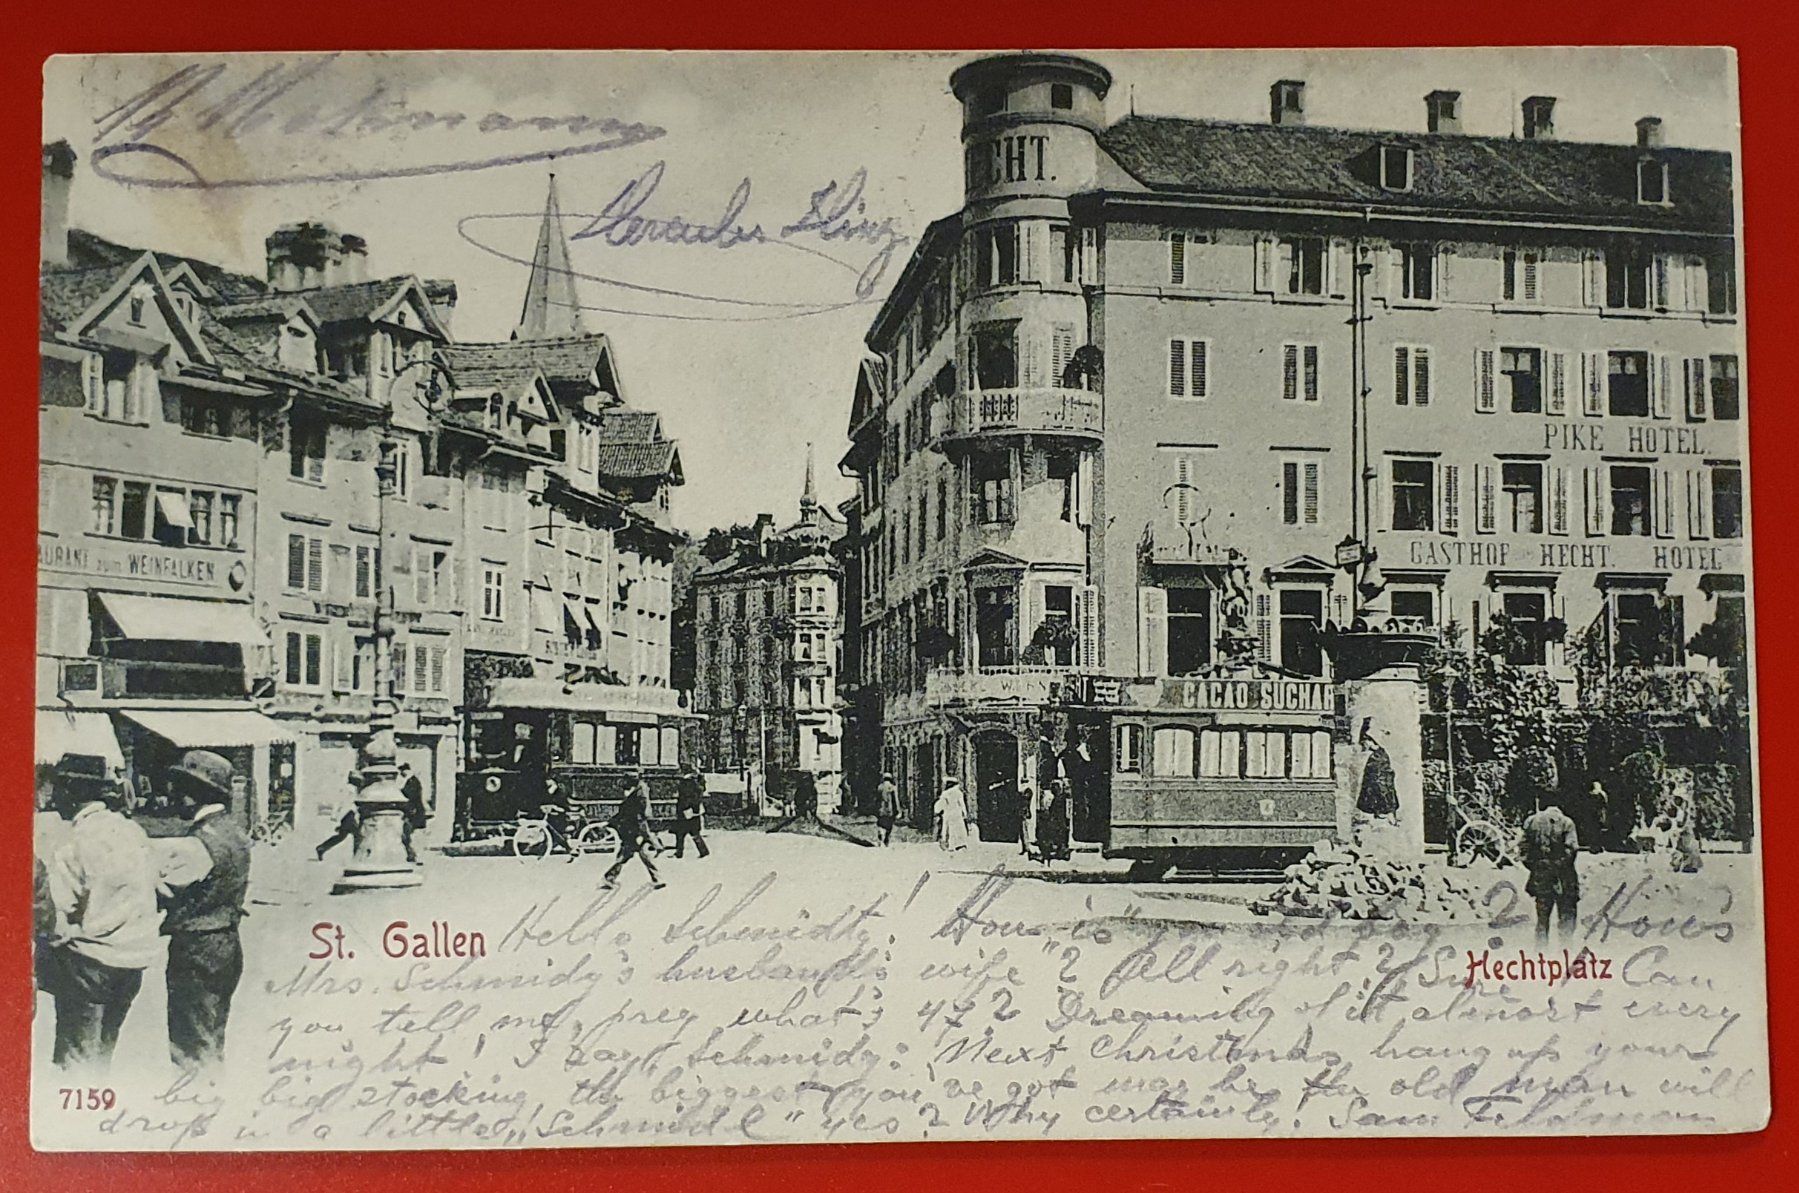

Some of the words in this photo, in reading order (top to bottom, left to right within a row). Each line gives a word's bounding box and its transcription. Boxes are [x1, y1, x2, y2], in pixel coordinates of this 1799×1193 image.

[1543, 424, 1604, 452] PIKE
[128, 553, 216, 582] WEINFALKEN
[1410, 541, 1510, 567] GASTHOF
[1183, 681, 1249, 709] CACAO
[308, 920, 355, 960] St.
[382, 920, 488, 959] Gallen
[1465, 947, 1613, 990] Hechtplatz
[58, 1087, 117, 1112] 7159
